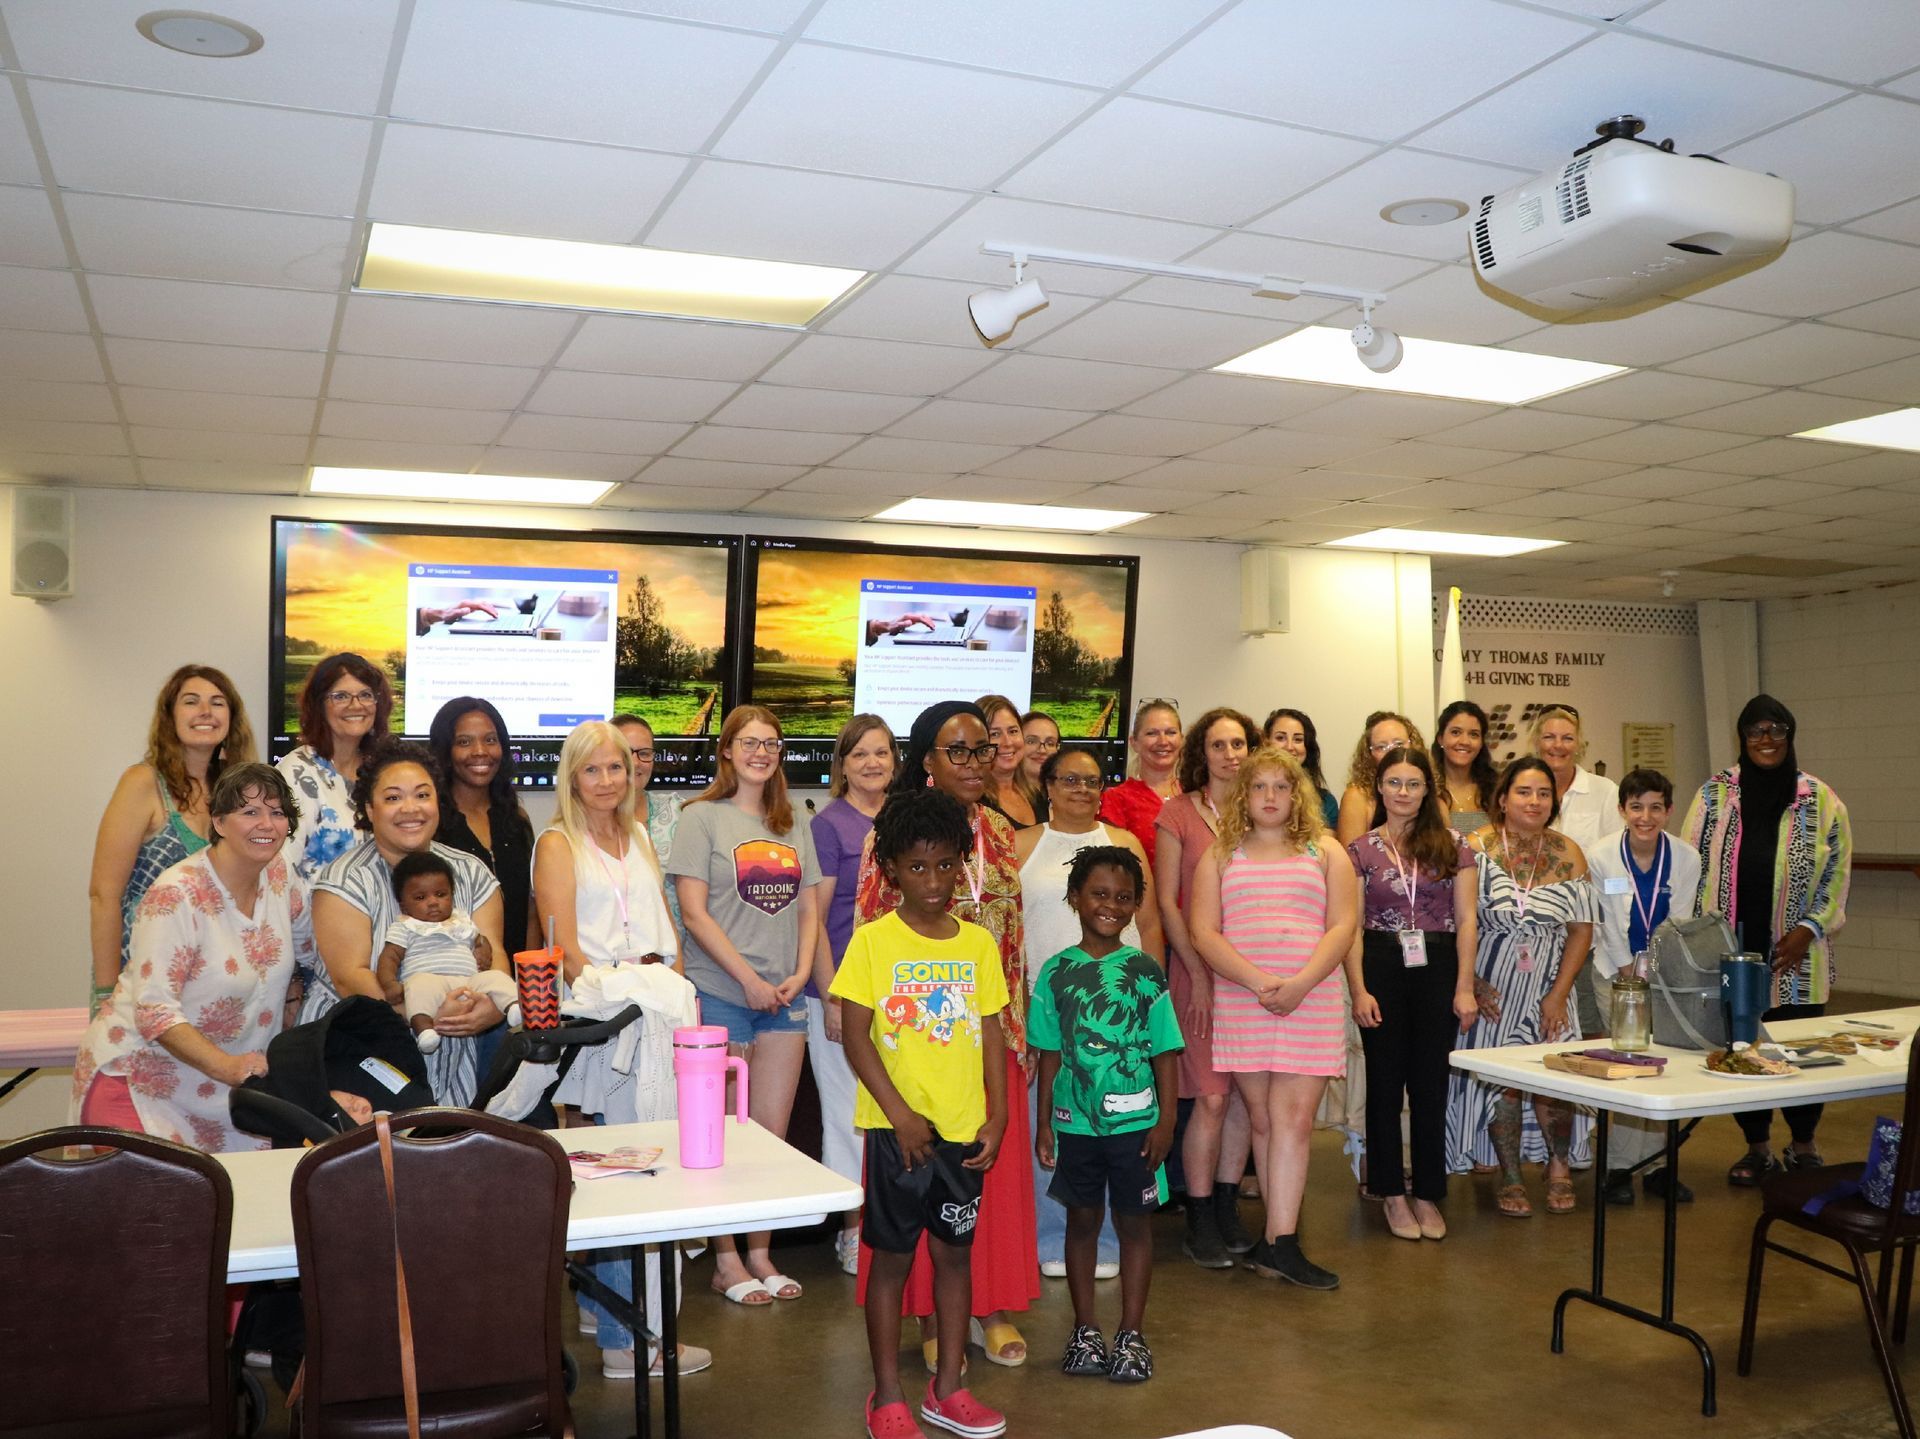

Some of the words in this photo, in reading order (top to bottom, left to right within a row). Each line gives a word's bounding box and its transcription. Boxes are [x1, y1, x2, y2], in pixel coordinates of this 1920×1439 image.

[1489, 650, 1549, 665] THOMAS
[1555, 652, 1606, 666] FAMILY
[1465, 671, 1485, 685] 4-H
[1488, 671, 1535, 686] GIVING
[1538, 673, 1570, 687] TREE
[747, 883, 795, 895] TATOOINE
[895, 962, 974, 984] SONIC
[895, 985, 916, 993] THE
